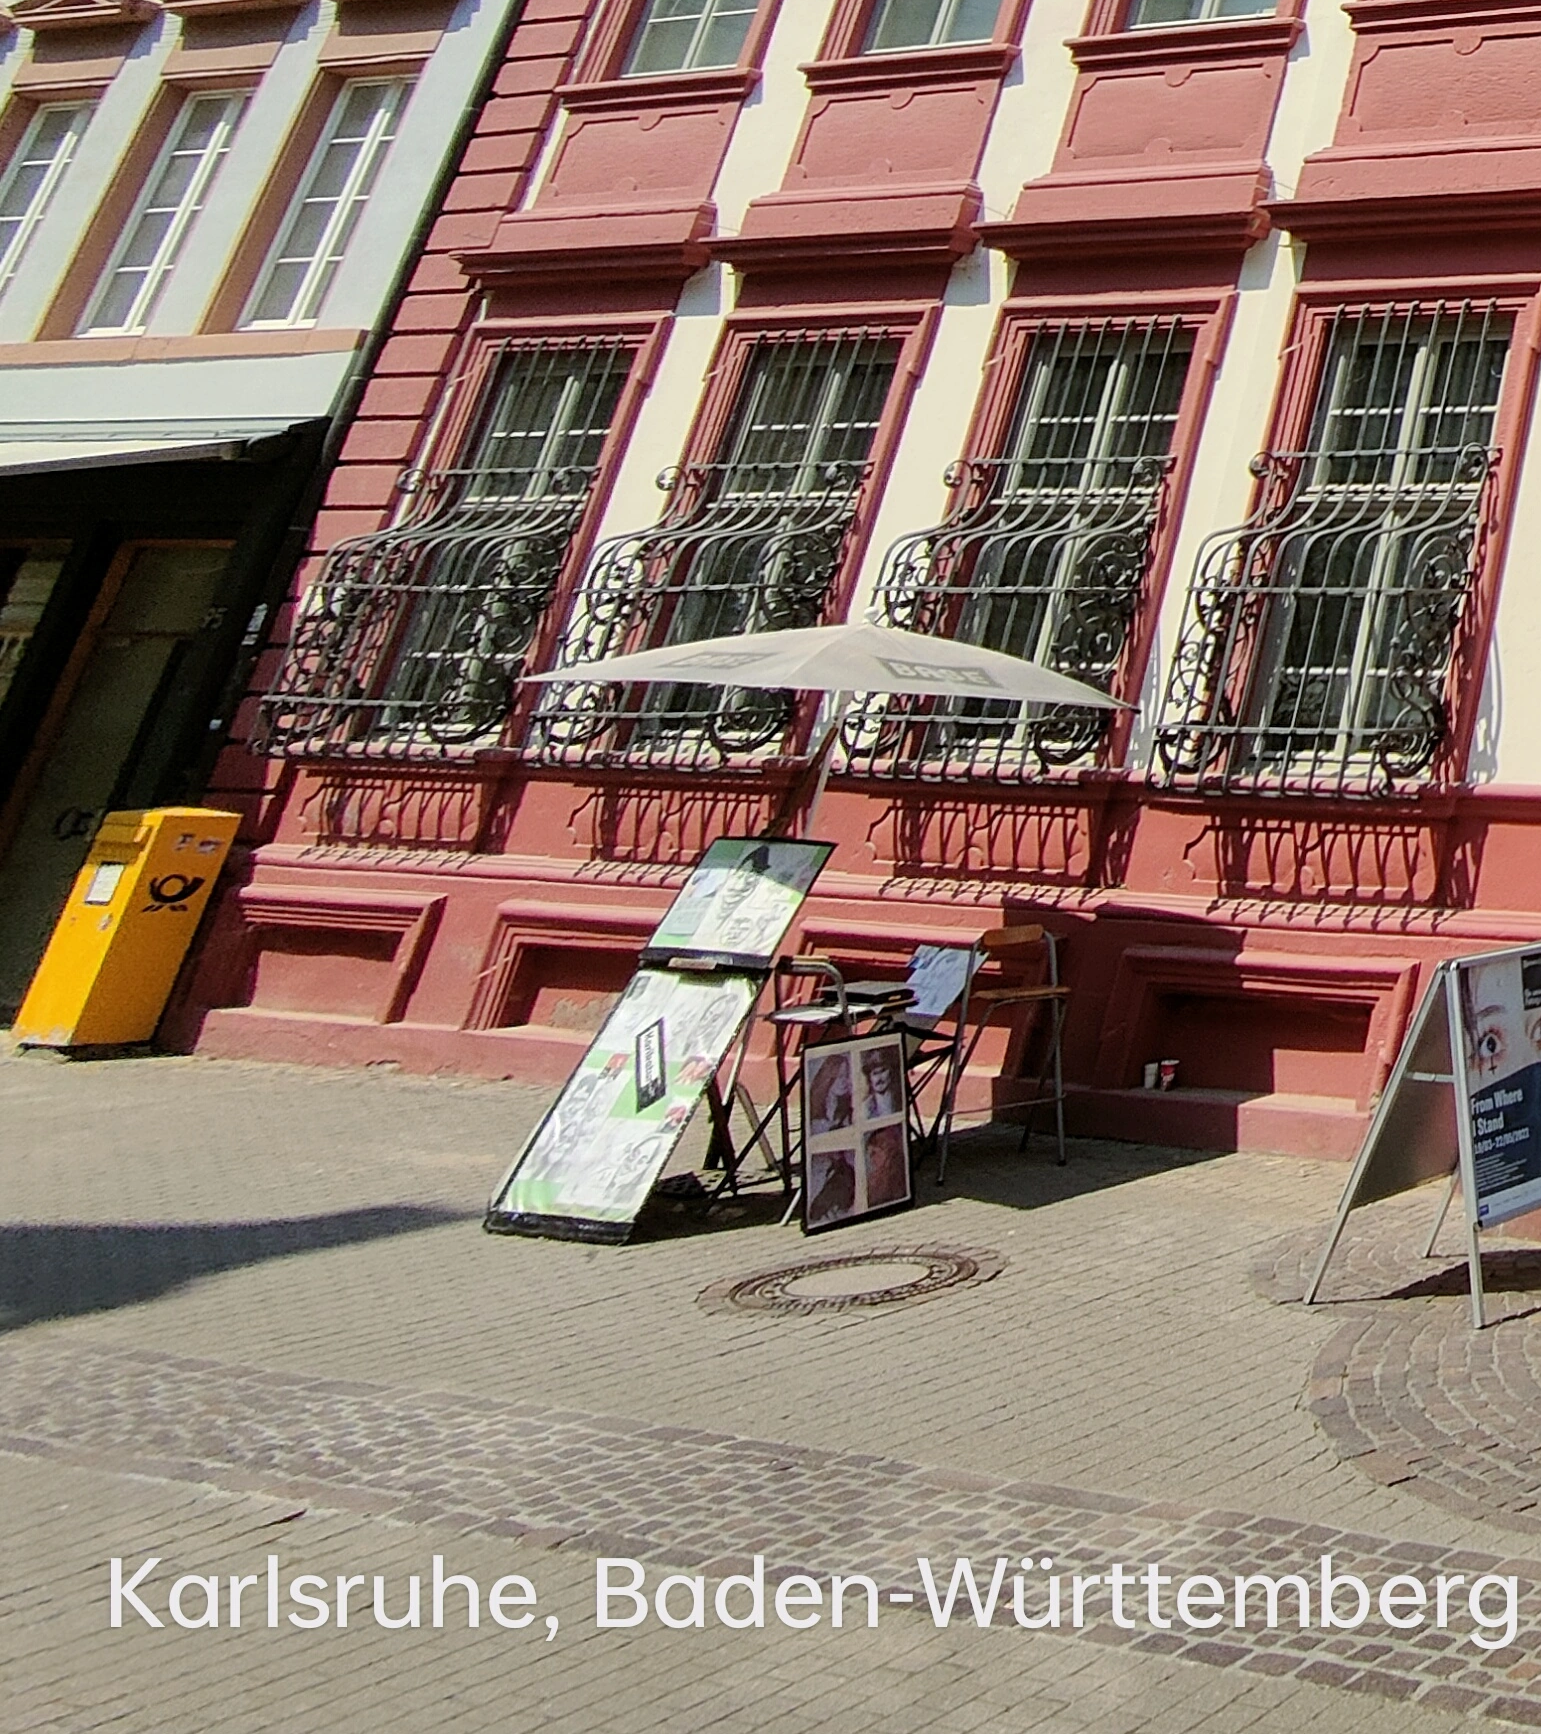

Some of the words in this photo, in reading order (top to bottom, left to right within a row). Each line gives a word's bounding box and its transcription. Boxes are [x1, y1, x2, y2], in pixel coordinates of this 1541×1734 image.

[892, 661, 991, 685] BASE
[1470, 1094, 1494, 1115] From
[1494, 1088, 1524, 1109] Where
[1477, 1111, 1504, 1136] Stand
